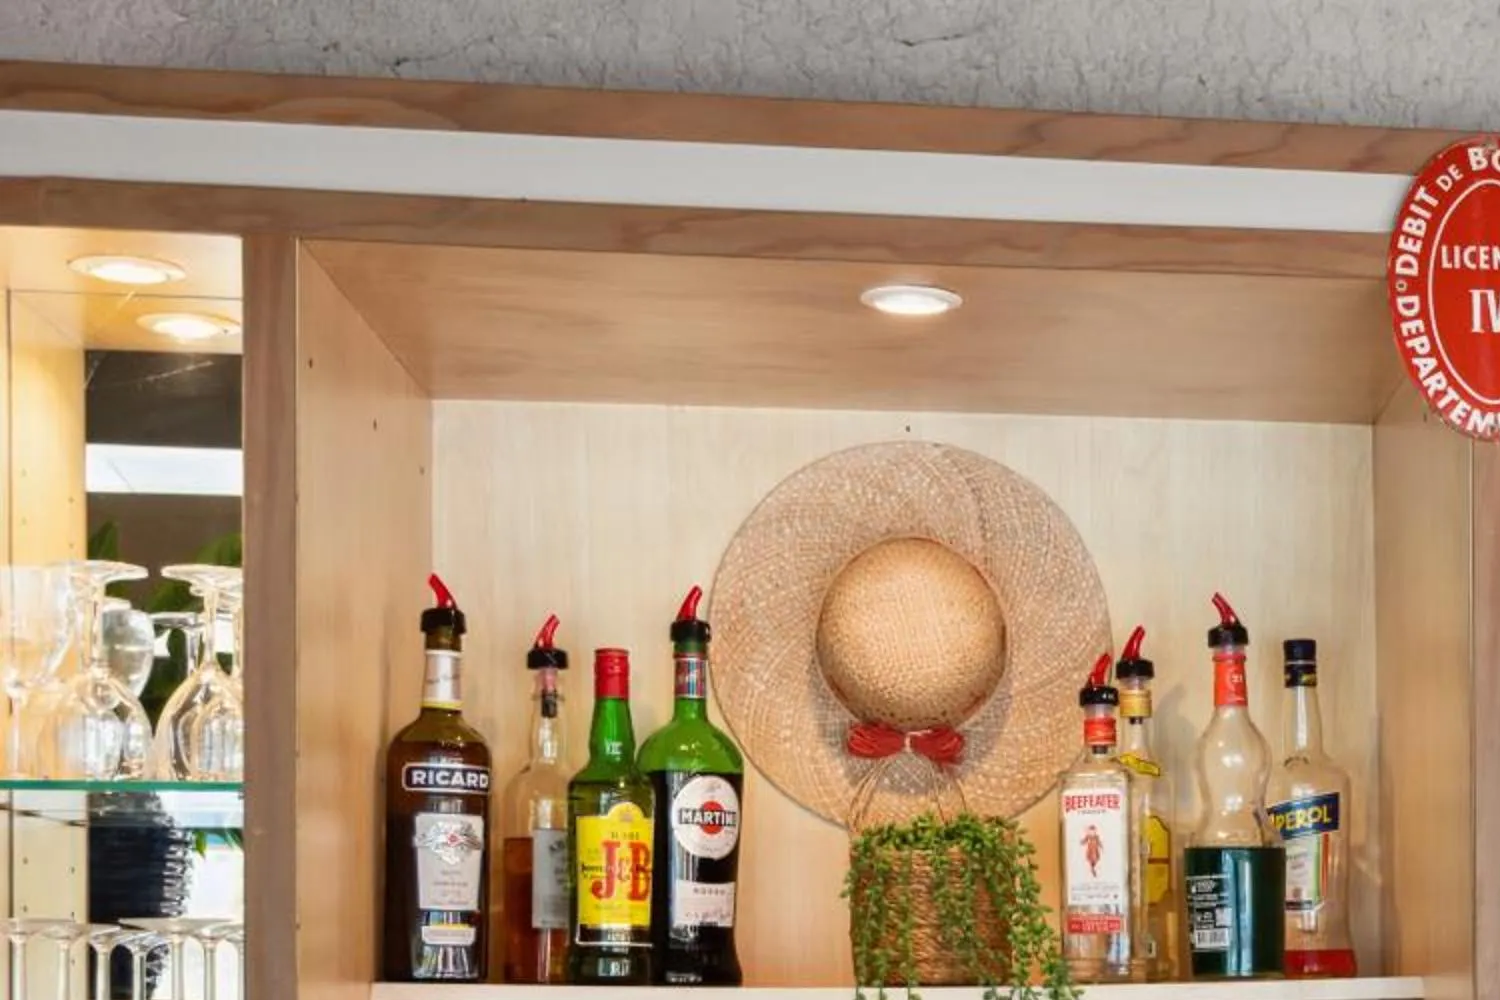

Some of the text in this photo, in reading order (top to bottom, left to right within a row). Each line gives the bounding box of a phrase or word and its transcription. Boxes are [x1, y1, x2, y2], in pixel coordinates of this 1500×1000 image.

[1396, 186, 1439, 278] DEBIT
[1436, 164, 1464, 192] DE
[411, 769, 489, 789] RICARD
[1064, 793, 1121, 813] BEEFEATER
